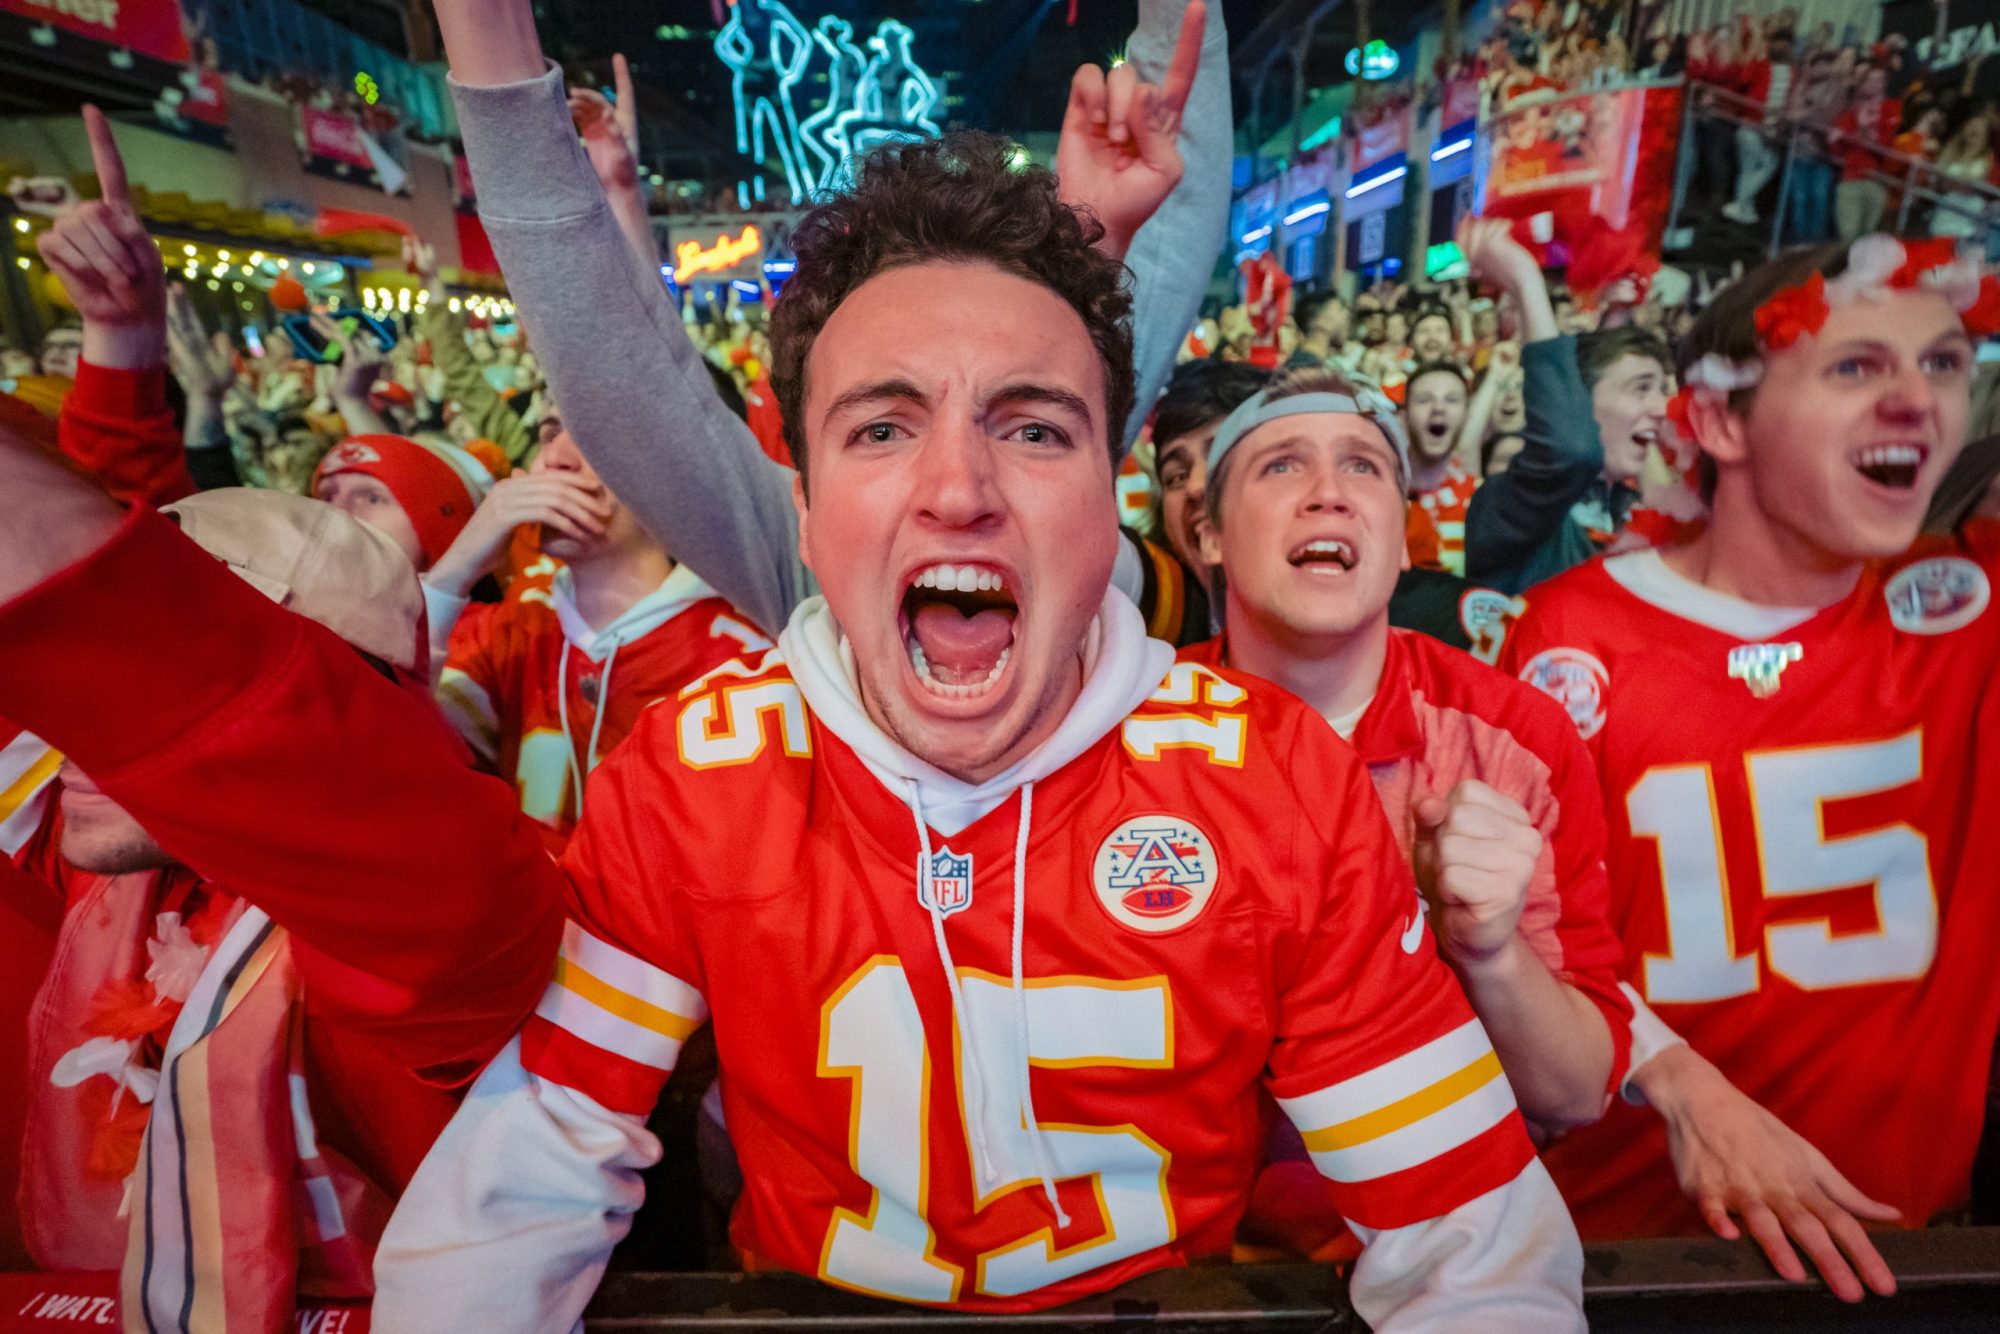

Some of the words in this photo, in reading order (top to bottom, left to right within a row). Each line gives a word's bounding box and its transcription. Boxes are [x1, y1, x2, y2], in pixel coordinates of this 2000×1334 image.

[1625, 724, 1939, 1005] 15
[816, 953, 1177, 1303] 15
[34, 1293, 116, 1325] WATC
